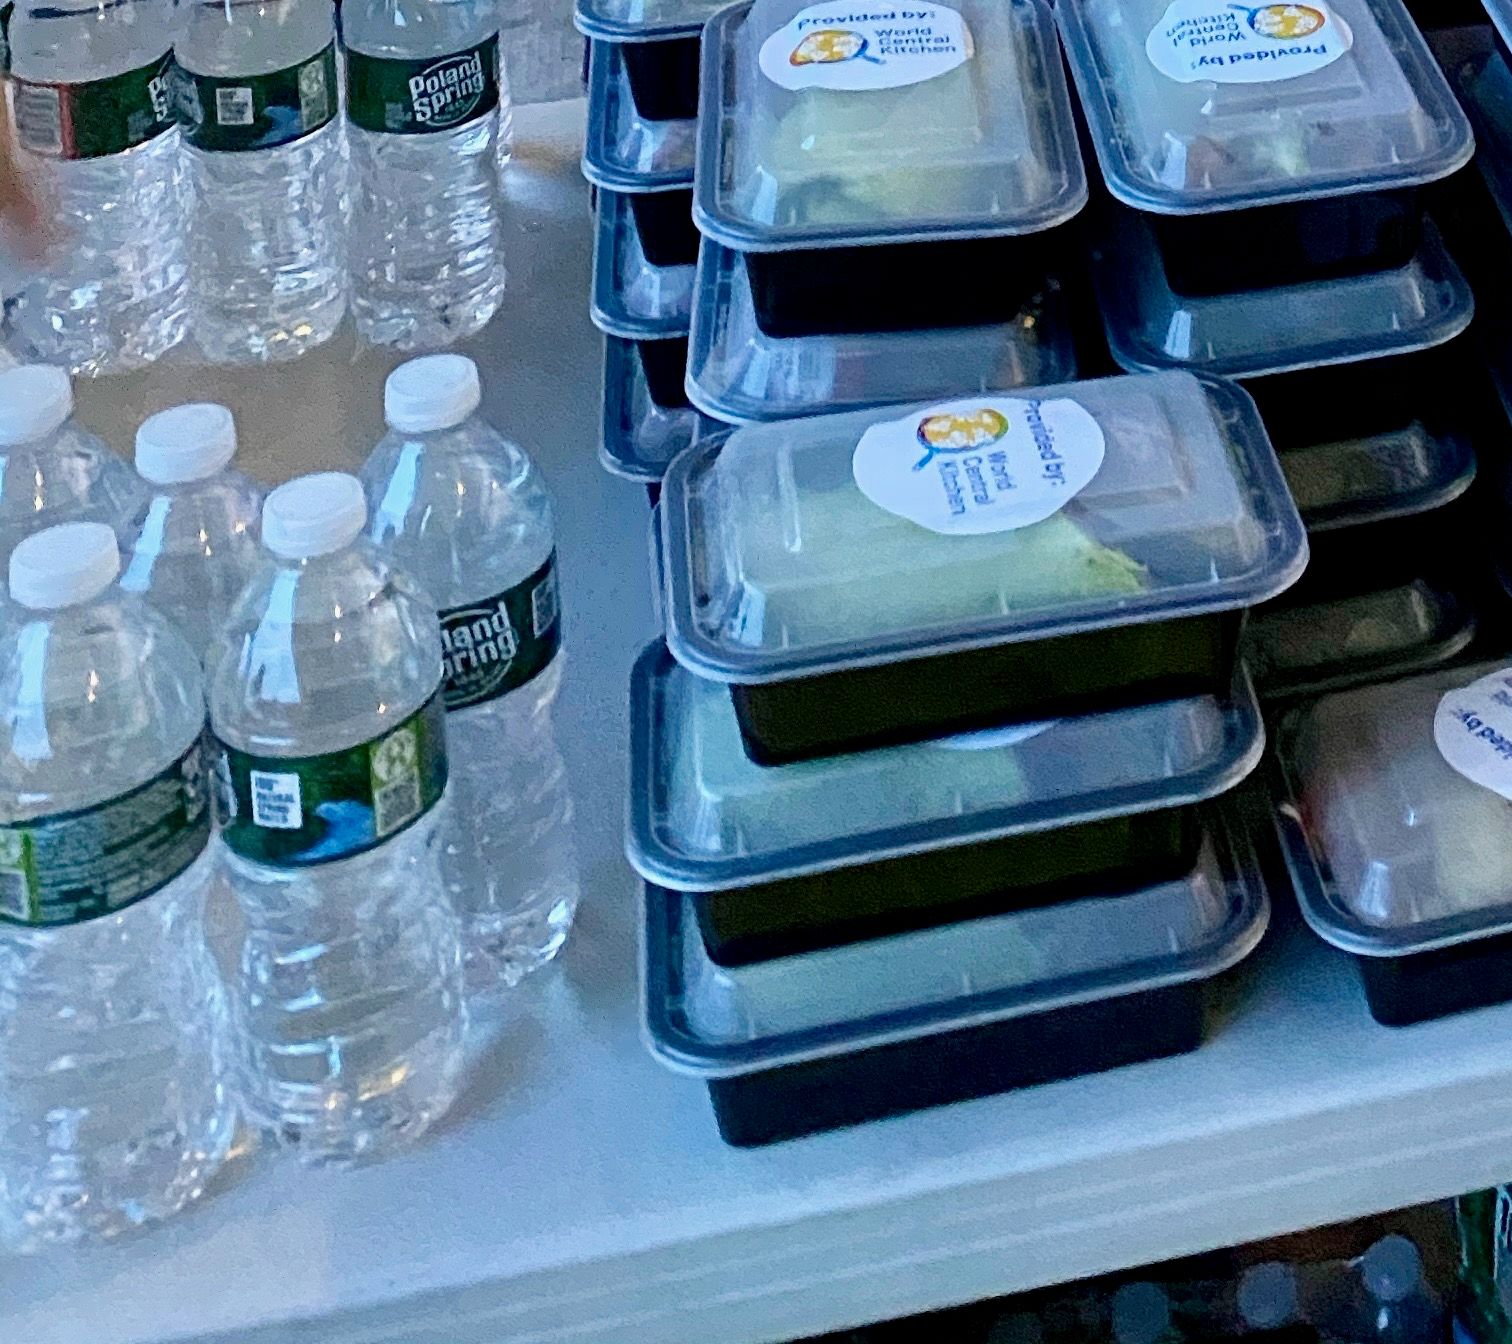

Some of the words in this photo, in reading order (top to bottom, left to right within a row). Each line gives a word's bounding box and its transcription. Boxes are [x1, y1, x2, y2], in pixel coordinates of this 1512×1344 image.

[797, 10, 897, 31] Provided
[1190, 30, 1248, 48] World
[408, 50, 482, 102] Poland
[1228, 44, 1328, 62] Provided
[414, 72, 484, 122] Spring
[442, 600, 511, 653] land
[443, 630, 517, 677] ring
